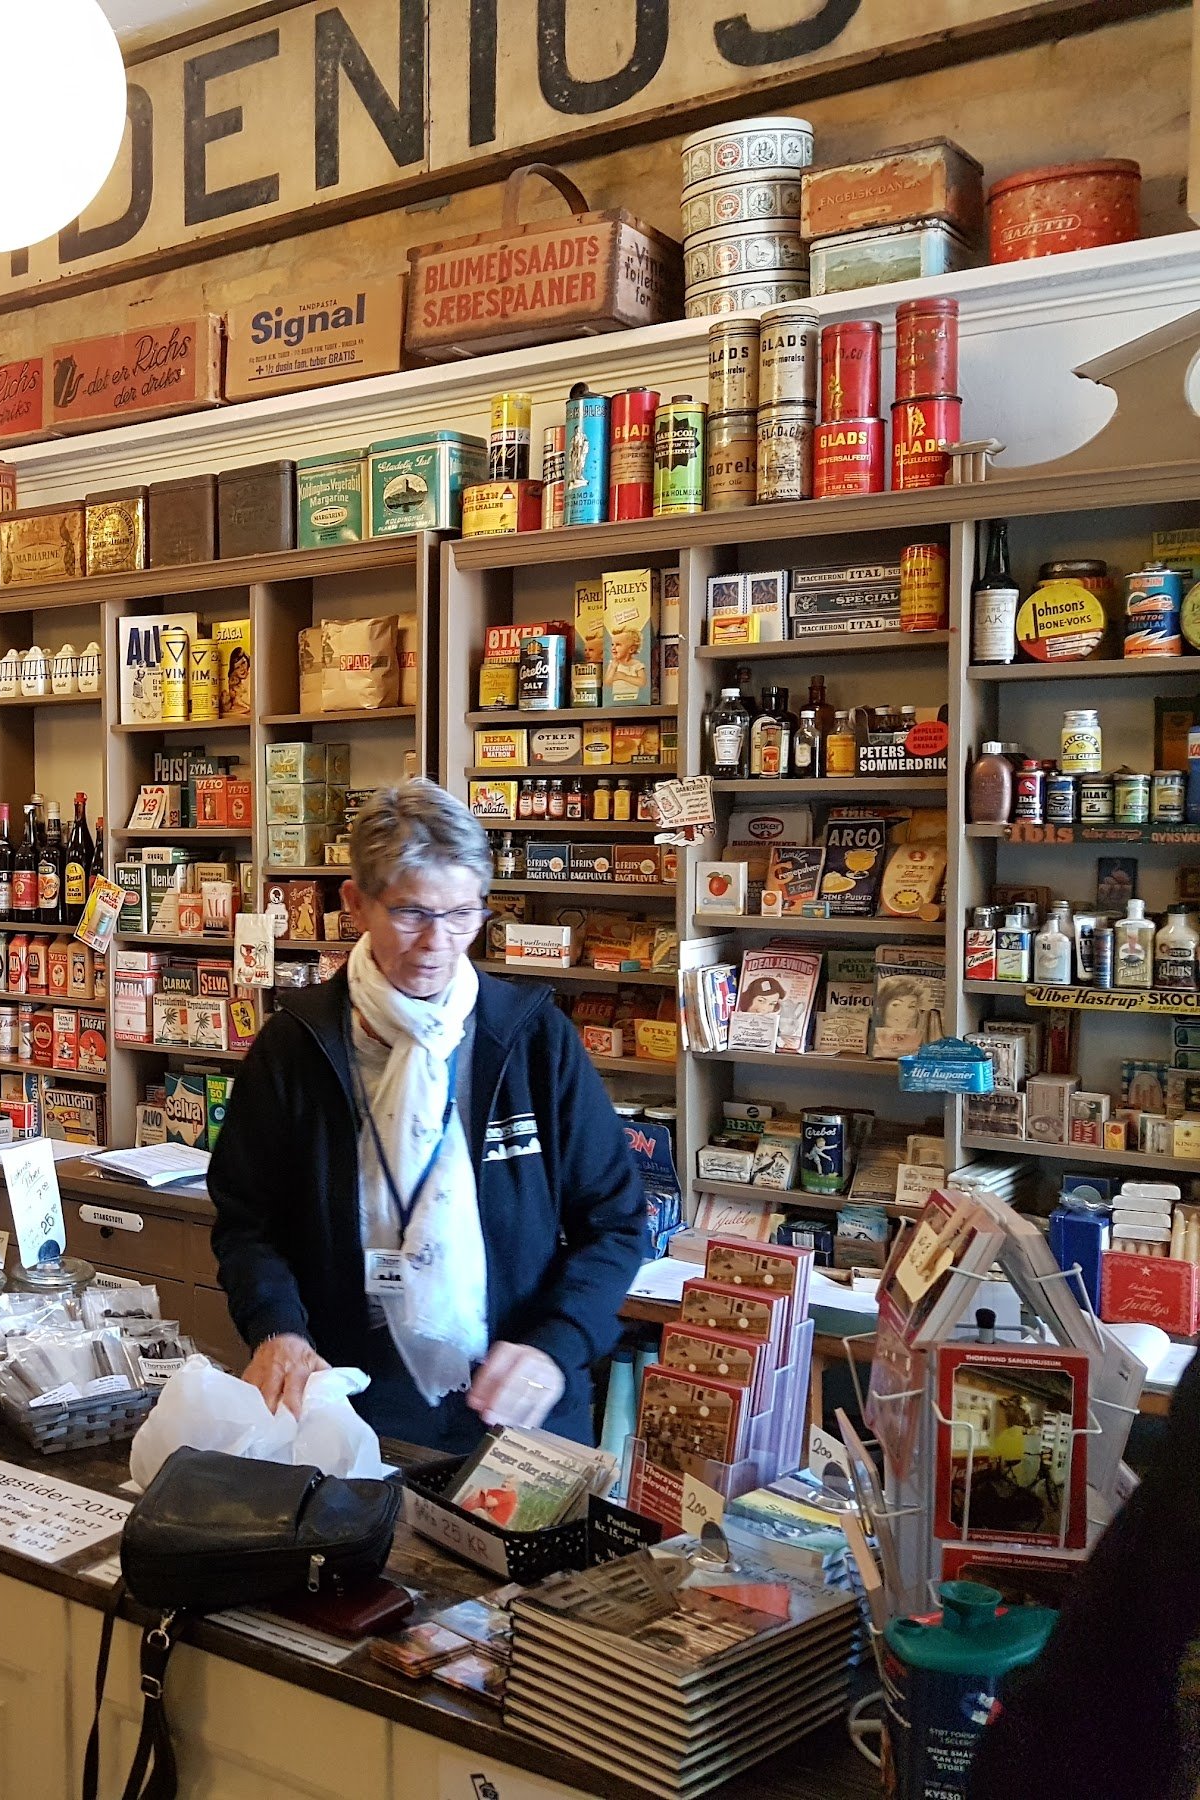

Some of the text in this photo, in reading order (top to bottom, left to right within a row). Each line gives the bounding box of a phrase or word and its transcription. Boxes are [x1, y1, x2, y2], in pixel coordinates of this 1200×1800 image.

[299, 299, 337, 311] TANDPASTA
[423, 271, 597, 328] SÆBESPAANER
[251, 293, 365, 346] Signal
[762, 334, 808, 352] GLADS
[133, 328, 191, 376] Richs
[309, 357, 327, 367] tuber
[328, 350, 355, 364] GRATIS
[820, 432, 867, 448] GLADS
[310, 493, 349, 507] Margarine
[15, 550, 61, 565] MARGARINE
[800, 569, 882, 582] MACCHERONI ITAL
[603, 580, 648, 611] FARLEY'S
[836, 593, 899, 604] SPECIAL
[801, 620, 882, 632] MACCHERONI ITAL
[1026, 600, 1085, 644] Johnson's
[1039, 615, 1091, 630] BONE-VOKS
[217, 627, 243, 641] STAGA
[340, 655, 370, 671] SPAR
[166, 668, 186, 679] VIM
[523, 681, 543, 690] SALT
[484, 735, 513, 743] RENA
[1063, 733, 1100, 753] NUGGET
[859, 746, 905, 758] PETERS
[190, 764, 213, 775] ZYMA
[859, 758, 947, 771] SOMMERDRIK
[473, 800, 508, 815] Melatin
[828, 828, 881, 847] ARGO
[119, 869, 141, 885] Persil
[524, 948, 560, 957] PAPIR
[9, 958, 21, 970] ATA
[748, 959, 776, 971] IDEAL
[116, 981, 144, 998] PATRIA
[163, 976, 191, 991] CLARAX
[201, 973, 229, 994] SELVA
[80, 1017, 106, 1031] TAGFAT
[46, 1092, 93, 1110] SUNLIGHT
[210, 1089, 223, 1098] 50
[142, 1109, 162, 1127] ALVO
[166, 1100, 201, 1121] Selva
[804, 1127, 836, 1139] Cerebos
[643, 1463, 683, 1491] Thorsvan
[71, 1498, 128, 1522] 2018
[440, 1520, 463, 1542] 25
[606, 1513, 641, 1536] Postkort
